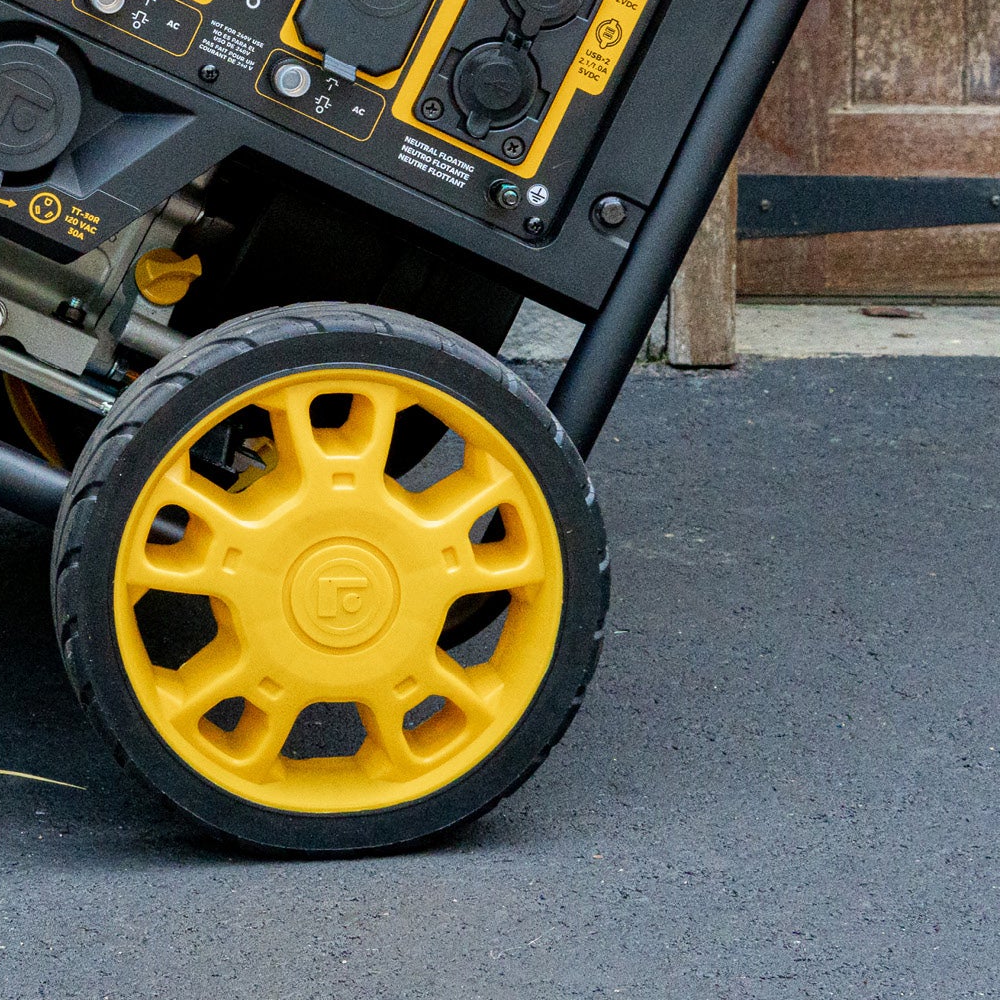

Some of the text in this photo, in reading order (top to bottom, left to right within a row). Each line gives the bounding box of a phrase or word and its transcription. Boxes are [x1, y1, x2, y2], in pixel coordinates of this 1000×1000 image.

[166, 20, 180, 30] AC
[210, 20, 264, 48] NOT FOR 240V USE
[213, 36, 226, 45] USO
[202, 38, 214, 48] PAS
[214, 44, 228, 53] FAIT
[228, 51, 245, 62] POUR
[231, 38, 247, 48] PARA
[199, 44, 227, 60] COURANT
[578, 67, 600, 82] 5VDC
[352, 106, 366, 116] AC
[401, 144, 470, 181] NEUTRO FLOTANTE
[404, 135, 475, 173] NEUTRAL FLOATING
[398, 153, 466, 189] NEUTRE FLOTTANT
[71, 206, 101, 225] TT-30R
[64, 215, 98, 235] 120 VAC
[67, 227, 85, 240] 30A
